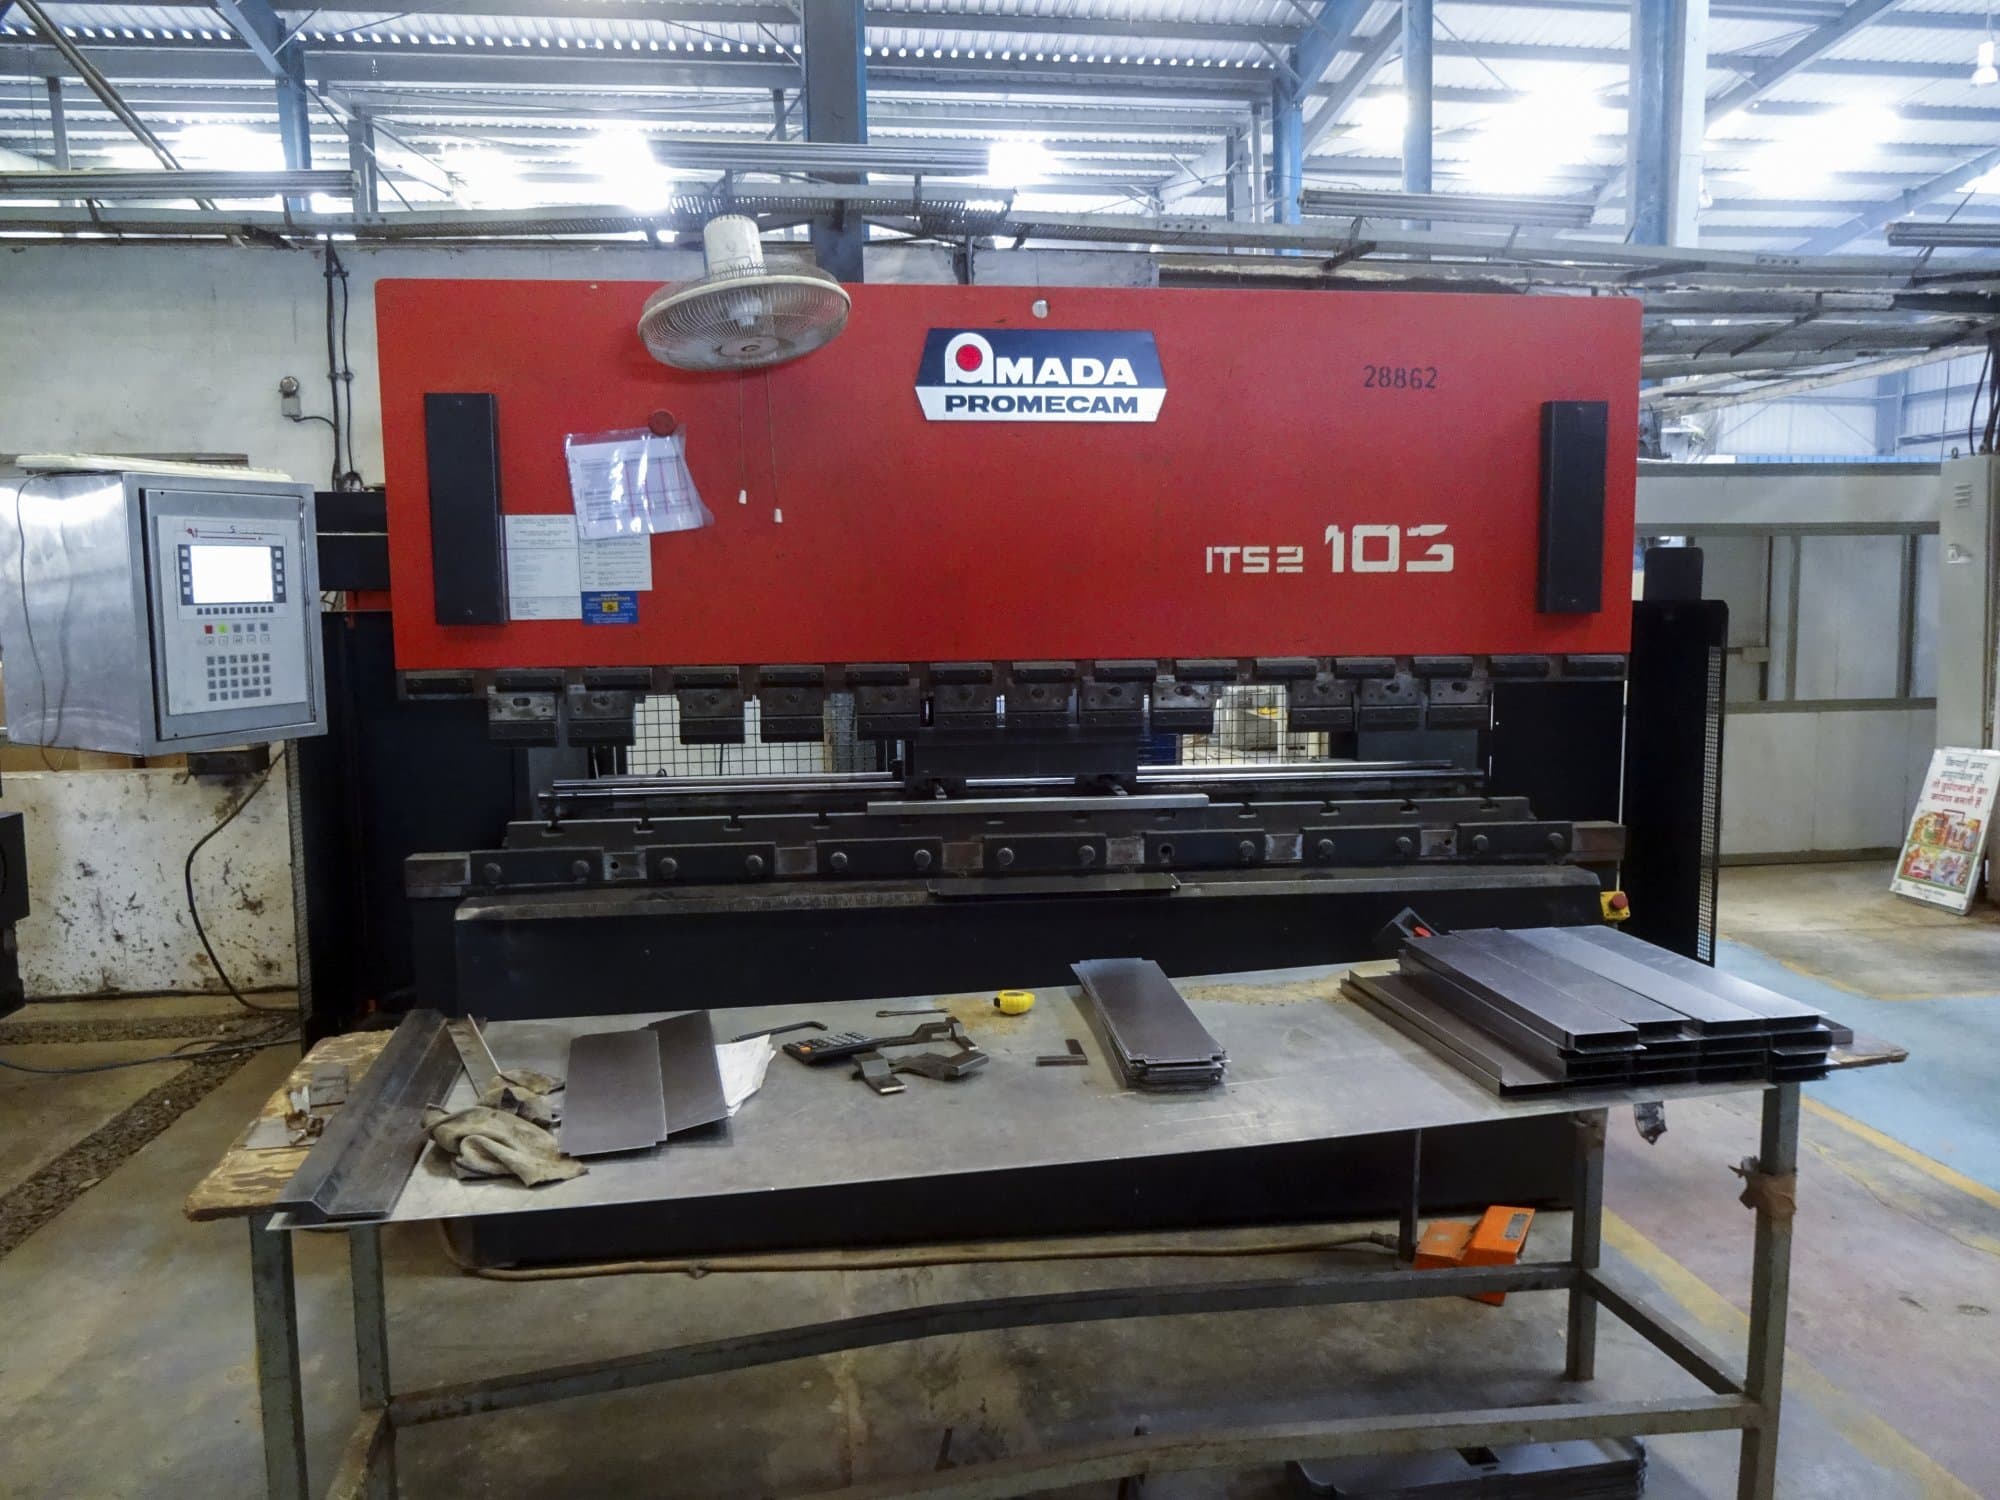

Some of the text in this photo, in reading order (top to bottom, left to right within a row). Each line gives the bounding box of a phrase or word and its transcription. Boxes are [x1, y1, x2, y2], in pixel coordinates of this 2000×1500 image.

[945, 332, 1138, 385] AMADA
[1364, 365, 1438, 390] 28862
[945, 395, 1138, 414] PROMECAM
[1324, 524, 1455, 574] 103
